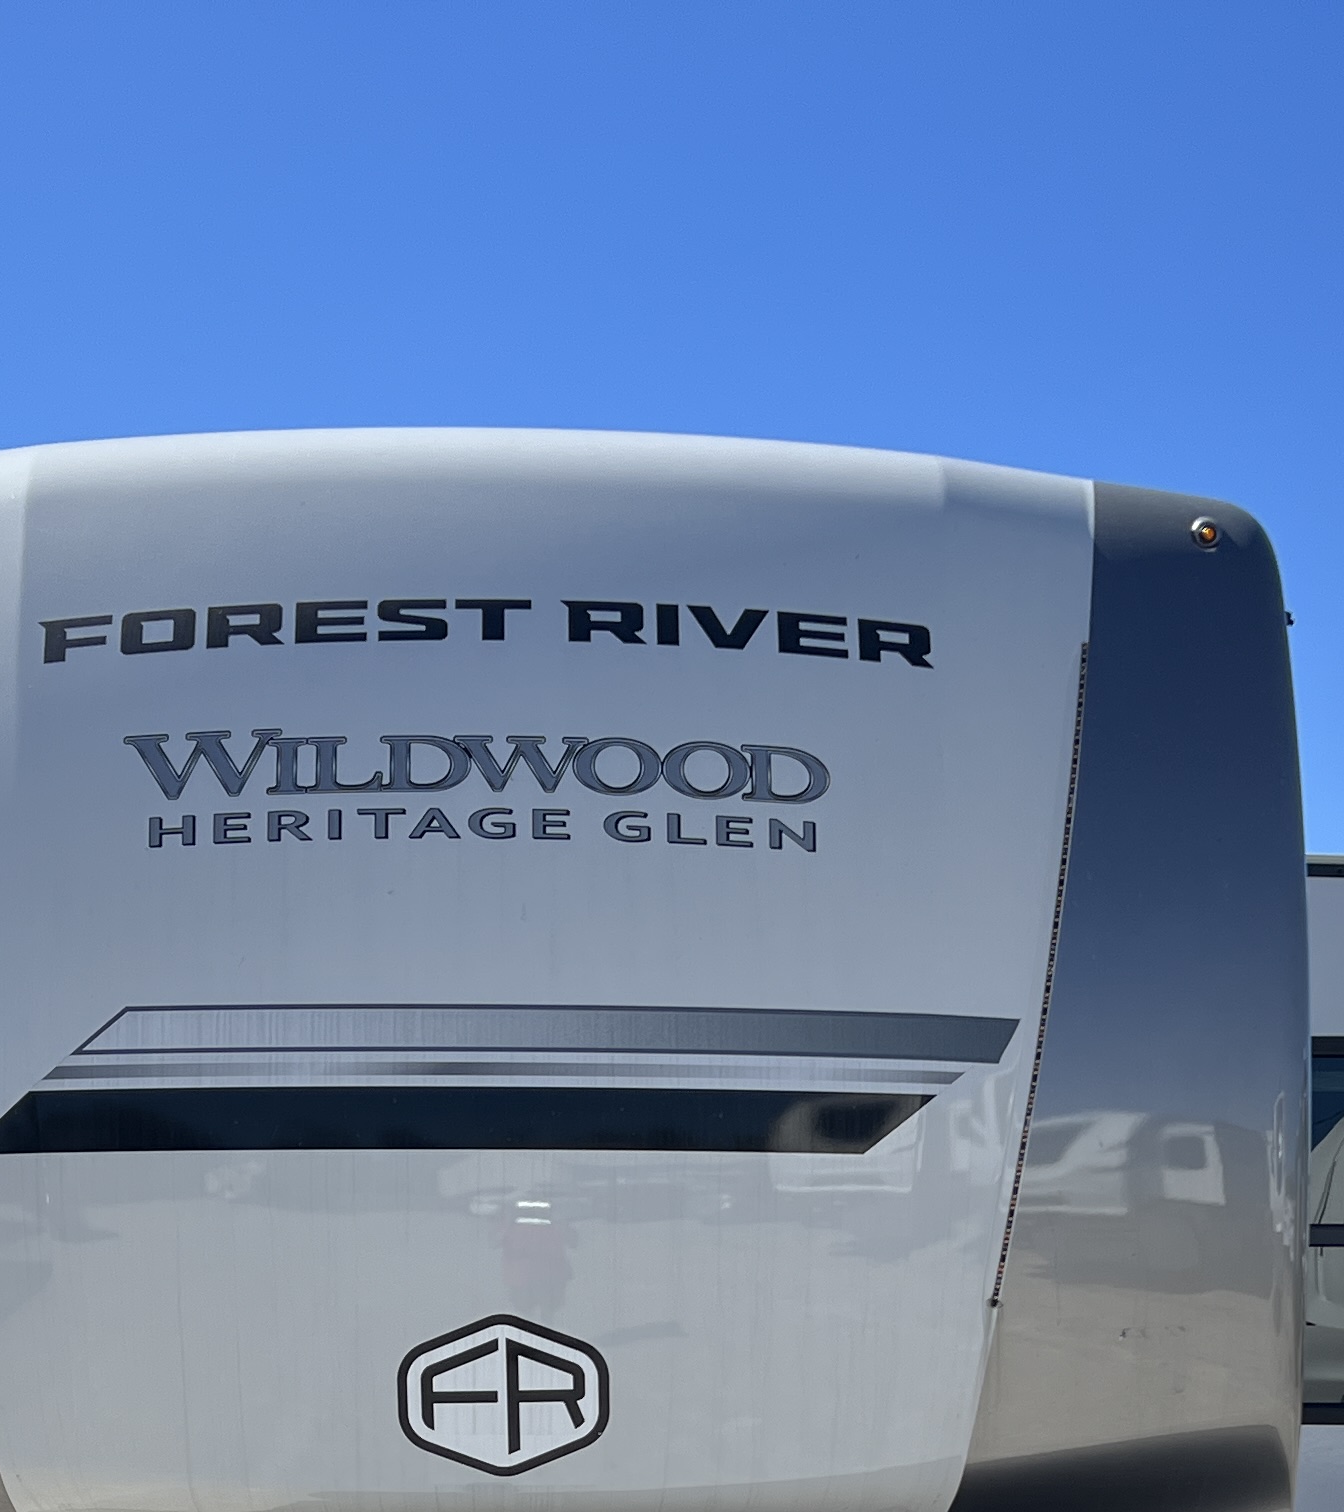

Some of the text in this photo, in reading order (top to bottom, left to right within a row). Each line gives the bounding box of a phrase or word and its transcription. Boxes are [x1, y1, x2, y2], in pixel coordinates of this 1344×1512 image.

[39, 599, 933, 668] FOREST RIVER
[123, 728, 831, 804] WILDWOOD
[147, 807, 817, 852] HERITAGE GLEN
